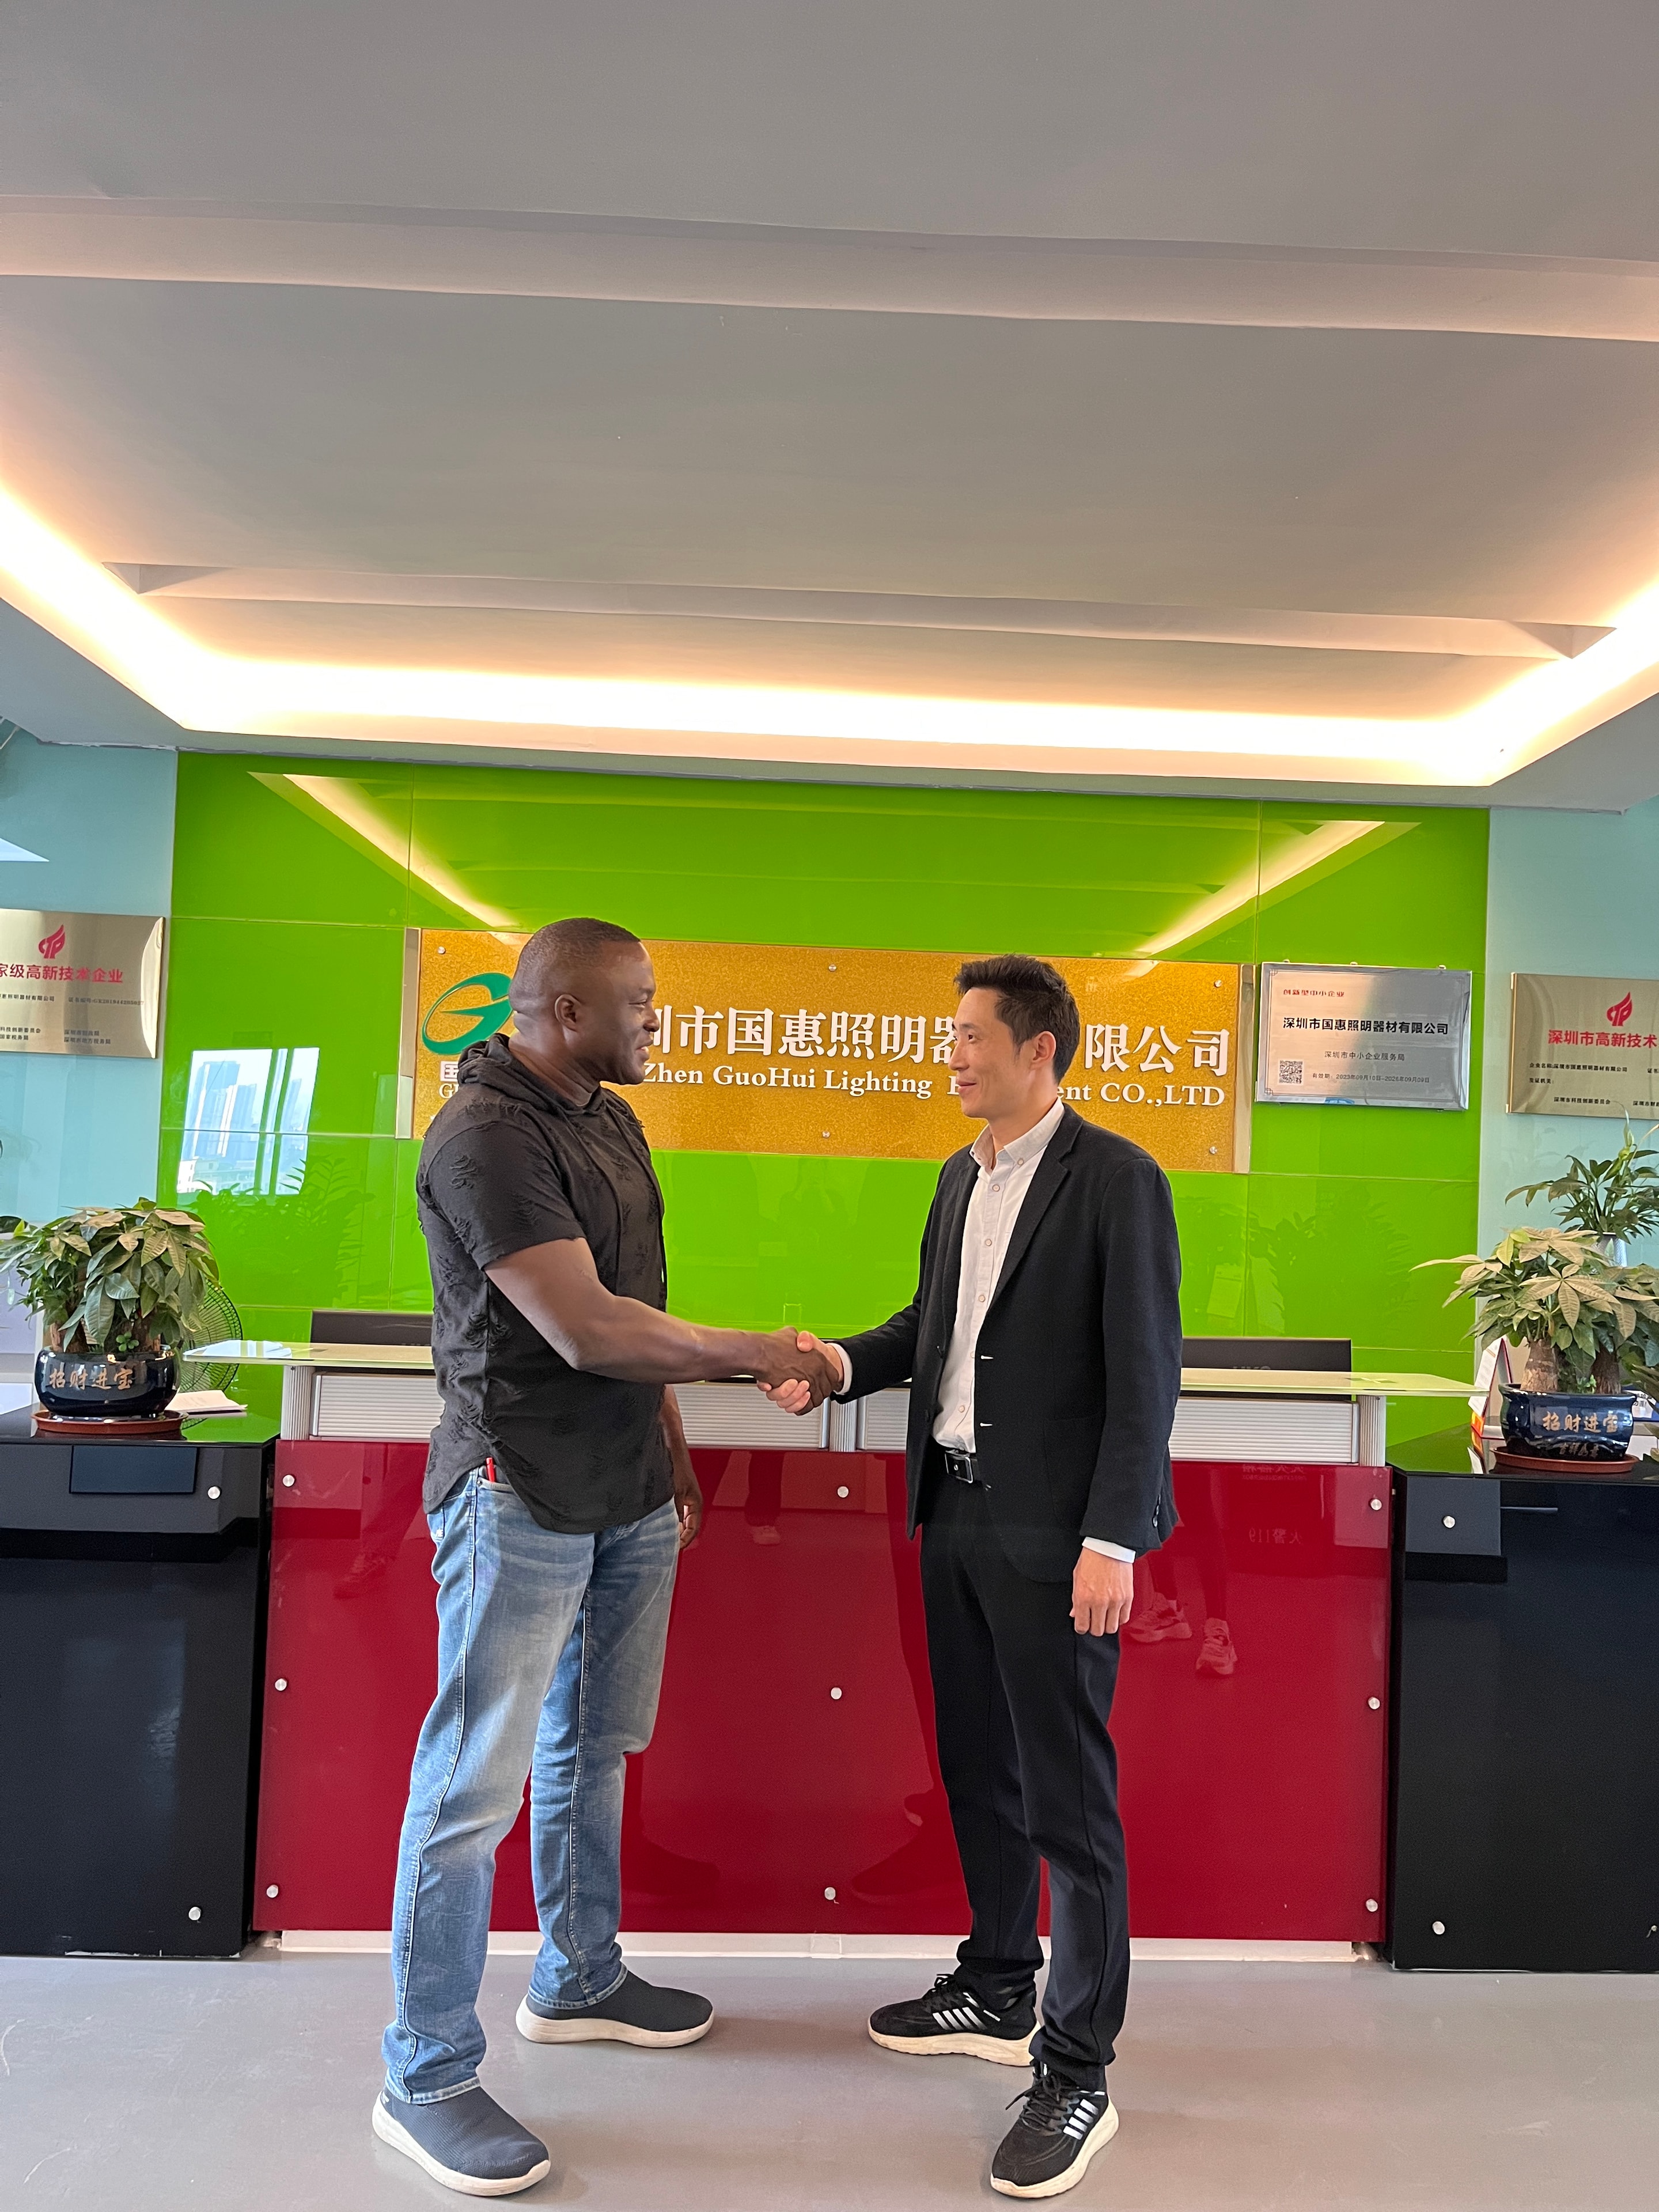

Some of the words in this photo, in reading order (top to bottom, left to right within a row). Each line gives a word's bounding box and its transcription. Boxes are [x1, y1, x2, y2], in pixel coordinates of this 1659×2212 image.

[1283, 989, 1344, 997] 创新型中小企业
[1282, 1017, 1448, 1035] 深圳市国惠照明器材有限公司
[1324, 1051, 1405, 1062] 深圳市中小企业服务局
[713, 1066, 815, 1088] GuoHui
[823, 1070, 933, 1099] Lighting
[1100, 1082, 1225, 1107] CO.,LTD
[49, 1368, 133, 1391] 招财进宝
[1542, 1411, 1619, 1433] 招财进宝
